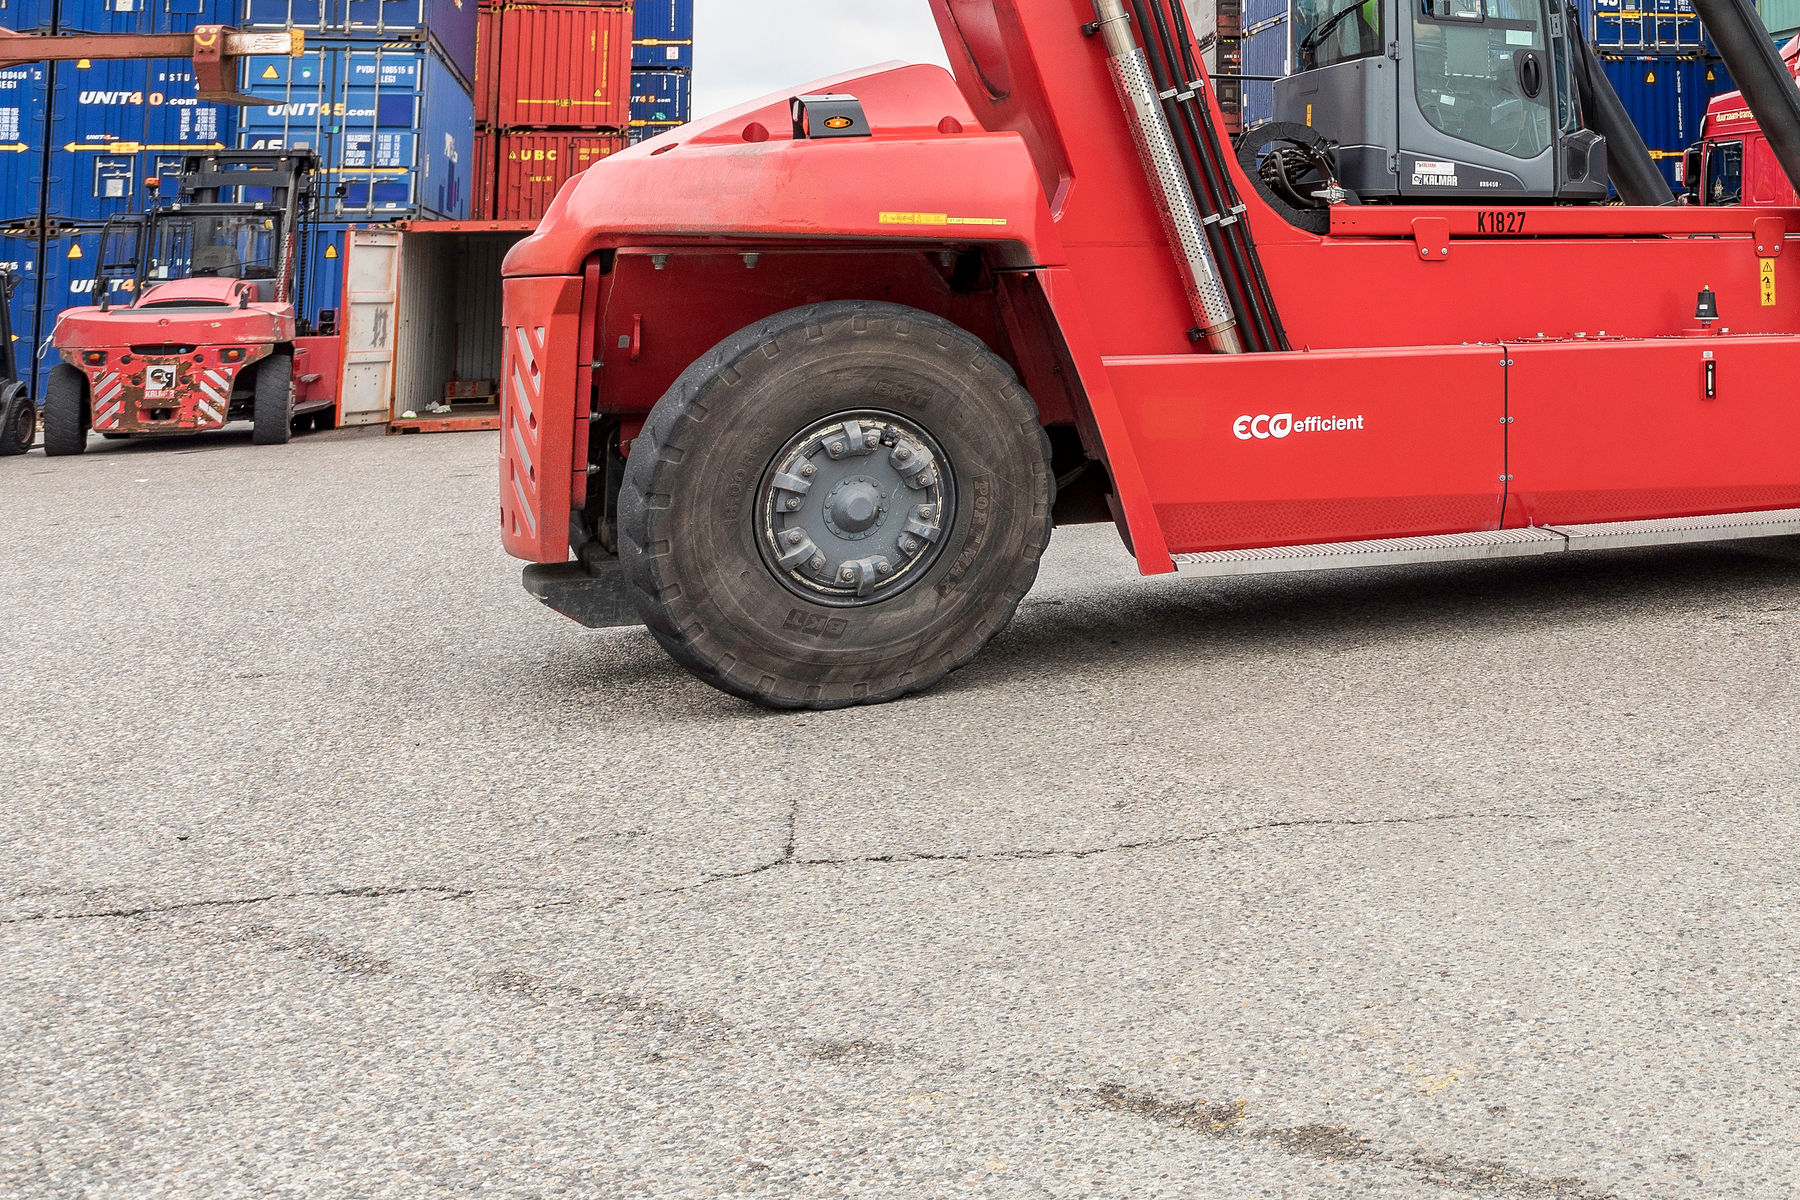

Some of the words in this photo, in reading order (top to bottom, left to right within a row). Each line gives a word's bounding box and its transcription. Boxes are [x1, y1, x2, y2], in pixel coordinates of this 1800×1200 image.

[520, 150, 557, 161] UBC
[1423, 174, 1458, 187] KALMAR
[1478, 211, 1526, 233] K1827
